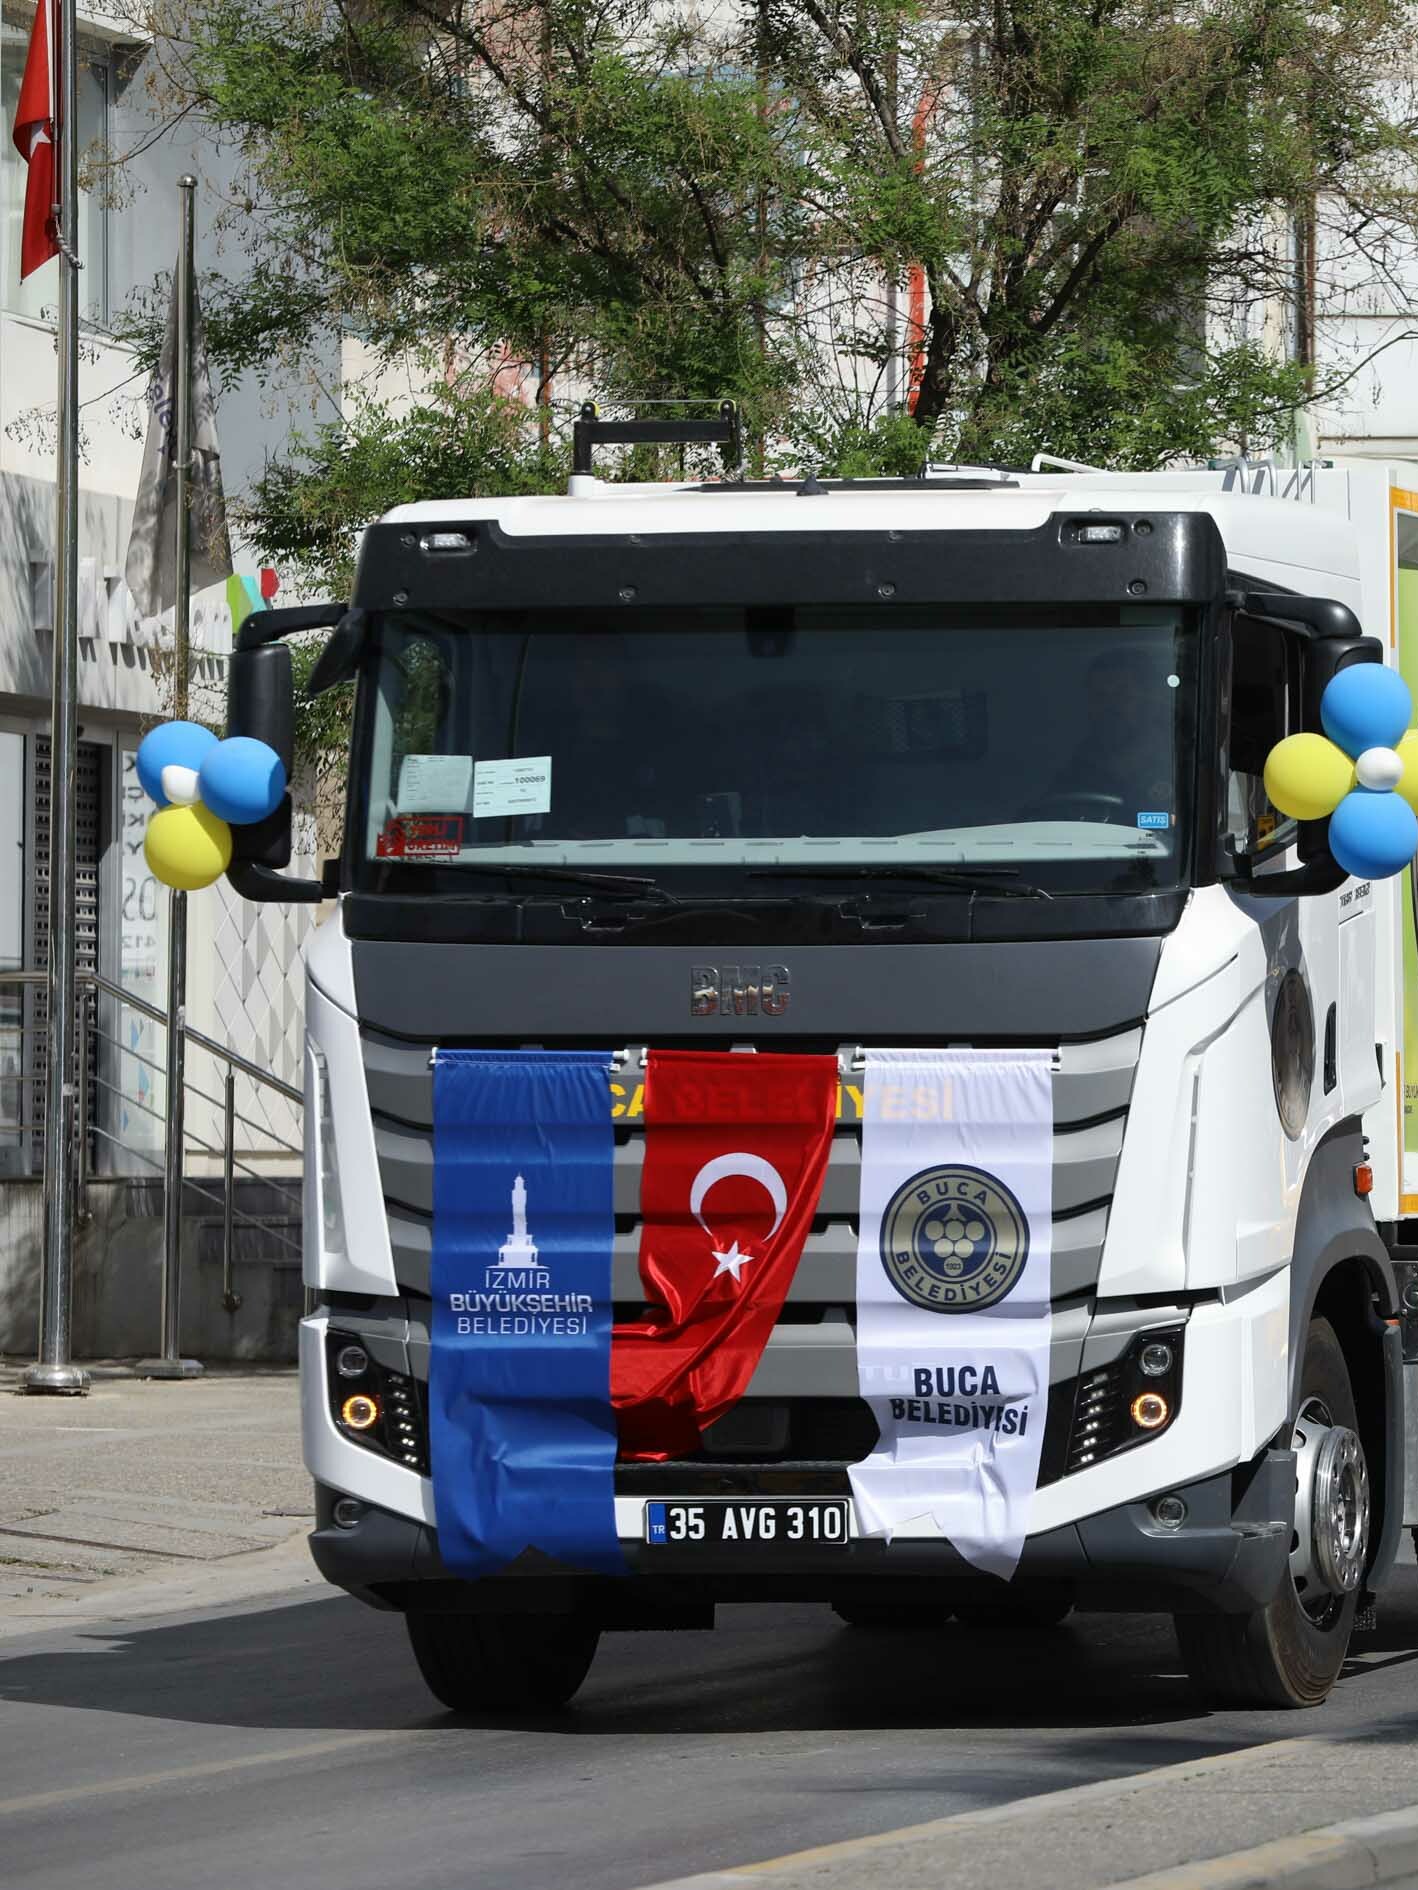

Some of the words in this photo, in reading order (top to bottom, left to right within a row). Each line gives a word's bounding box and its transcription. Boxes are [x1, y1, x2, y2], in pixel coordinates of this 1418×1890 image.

[690, 965, 791, 1015] BMC
[916, 1181, 989, 1206] BUCA
[485, 1270, 550, 1288] İZMİR
[895, 1250, 1013, 1301] BELEDİYESİ
[450, 1290, 593, 1314] BÜYÜKŞEHİR
[457, 1316, 587, 1335] BELEDİYESİ
[914, 1366, 1000, 1398] BUCA
[890, 1398, 1030, 1437] BELEDİYESİ
[652, 1525, 665, 1535] TR
[669, 1507, 705, 1540] 35
[722, 1507, 776, 1540] AVG
[786, 1506, 841, 1539] 310
